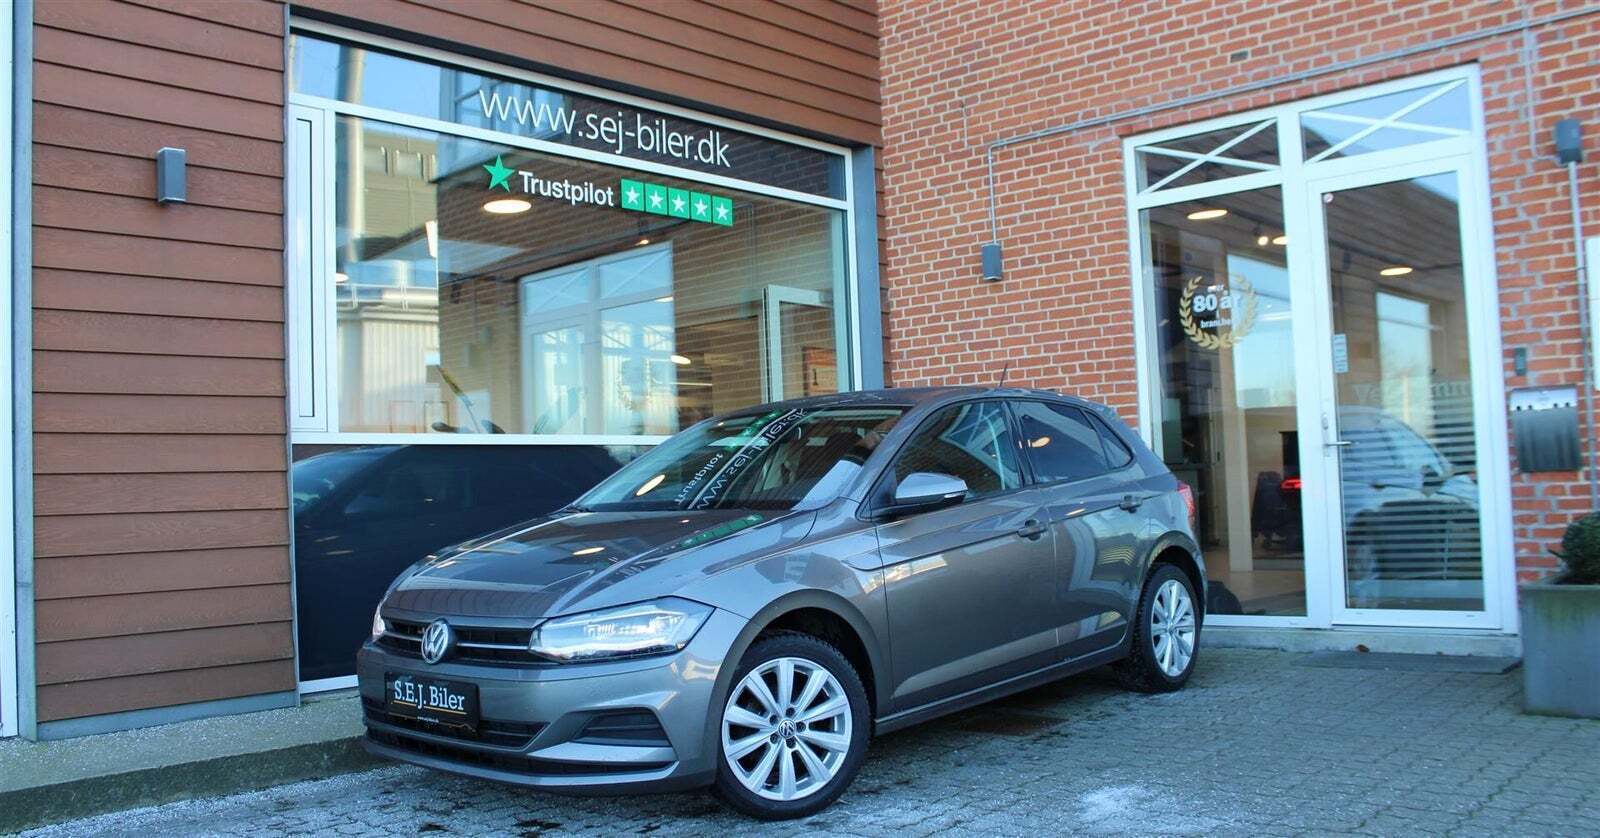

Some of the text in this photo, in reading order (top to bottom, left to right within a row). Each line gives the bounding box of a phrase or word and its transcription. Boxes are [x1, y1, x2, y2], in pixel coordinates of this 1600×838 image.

[480, 88, 731, 167] www.sej-biler.dk
[519, 170, 614, 207] Trustpilot
[1193, 293, 1217, 313] 80
[394, 680, 465, 711] S.E.J. Biler
